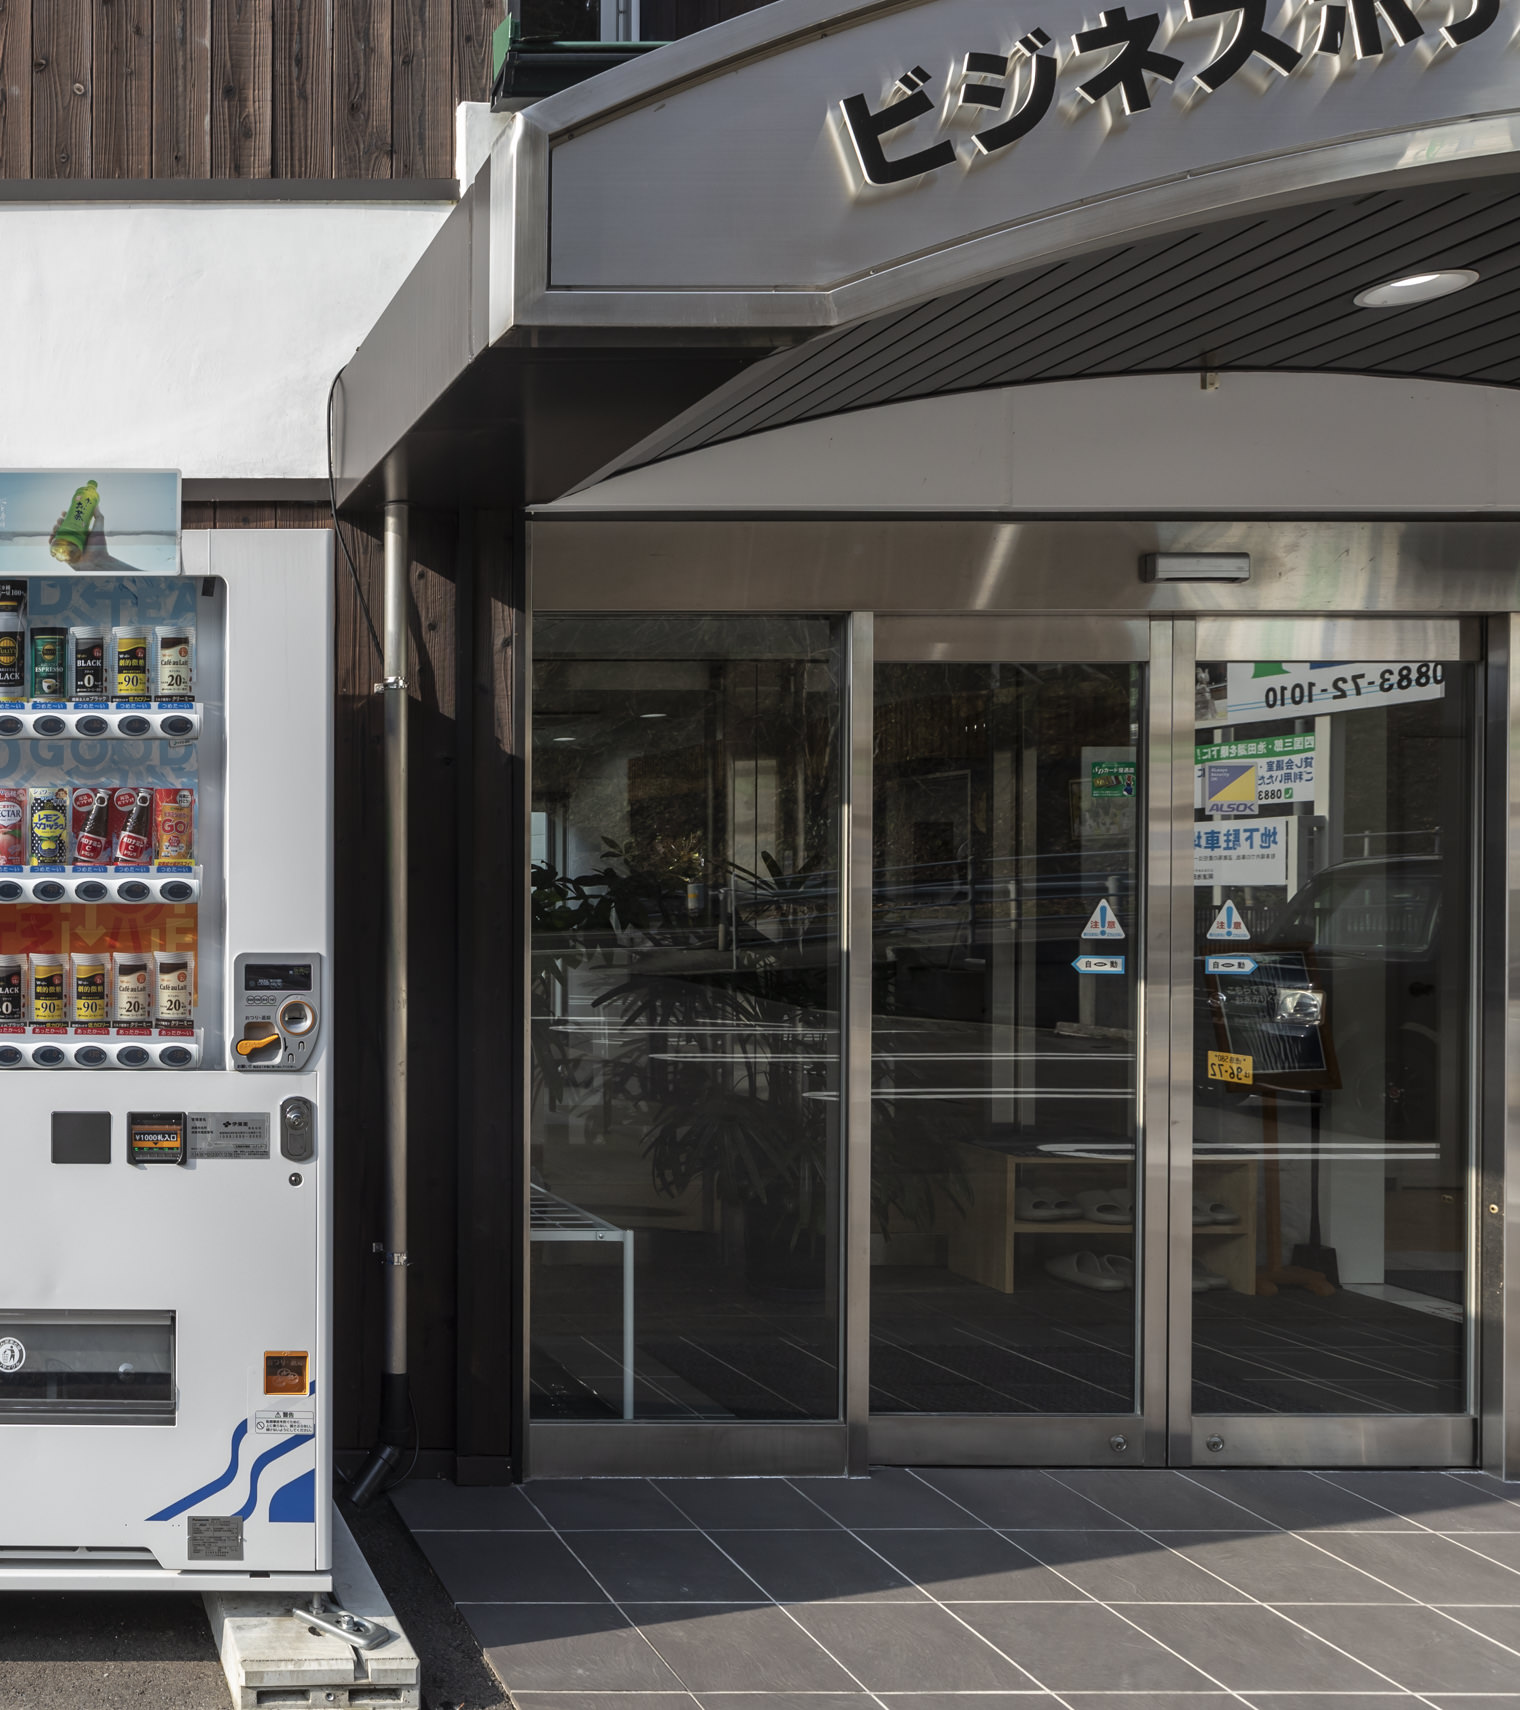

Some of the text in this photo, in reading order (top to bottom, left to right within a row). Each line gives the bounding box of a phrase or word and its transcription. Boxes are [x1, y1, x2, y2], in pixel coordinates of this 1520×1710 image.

[838, 0, 1500, 187] ビジネスホ
[84, 674, 94, 687] 0
[124, 675, 139, 687] 90
[168, 674, 182, 687] 20
[1208, 803, 1255, 813] ALSOK
[33, 822, 64, 830] スカッシュ
[2, 1001, 12, 1014] 0
[41, 1001, 56, 1013] 90
[83, 1001, 98, 1013] 90
[125, 1001, 140, 1012] 20
[166, 999, 181, 1011] 20
